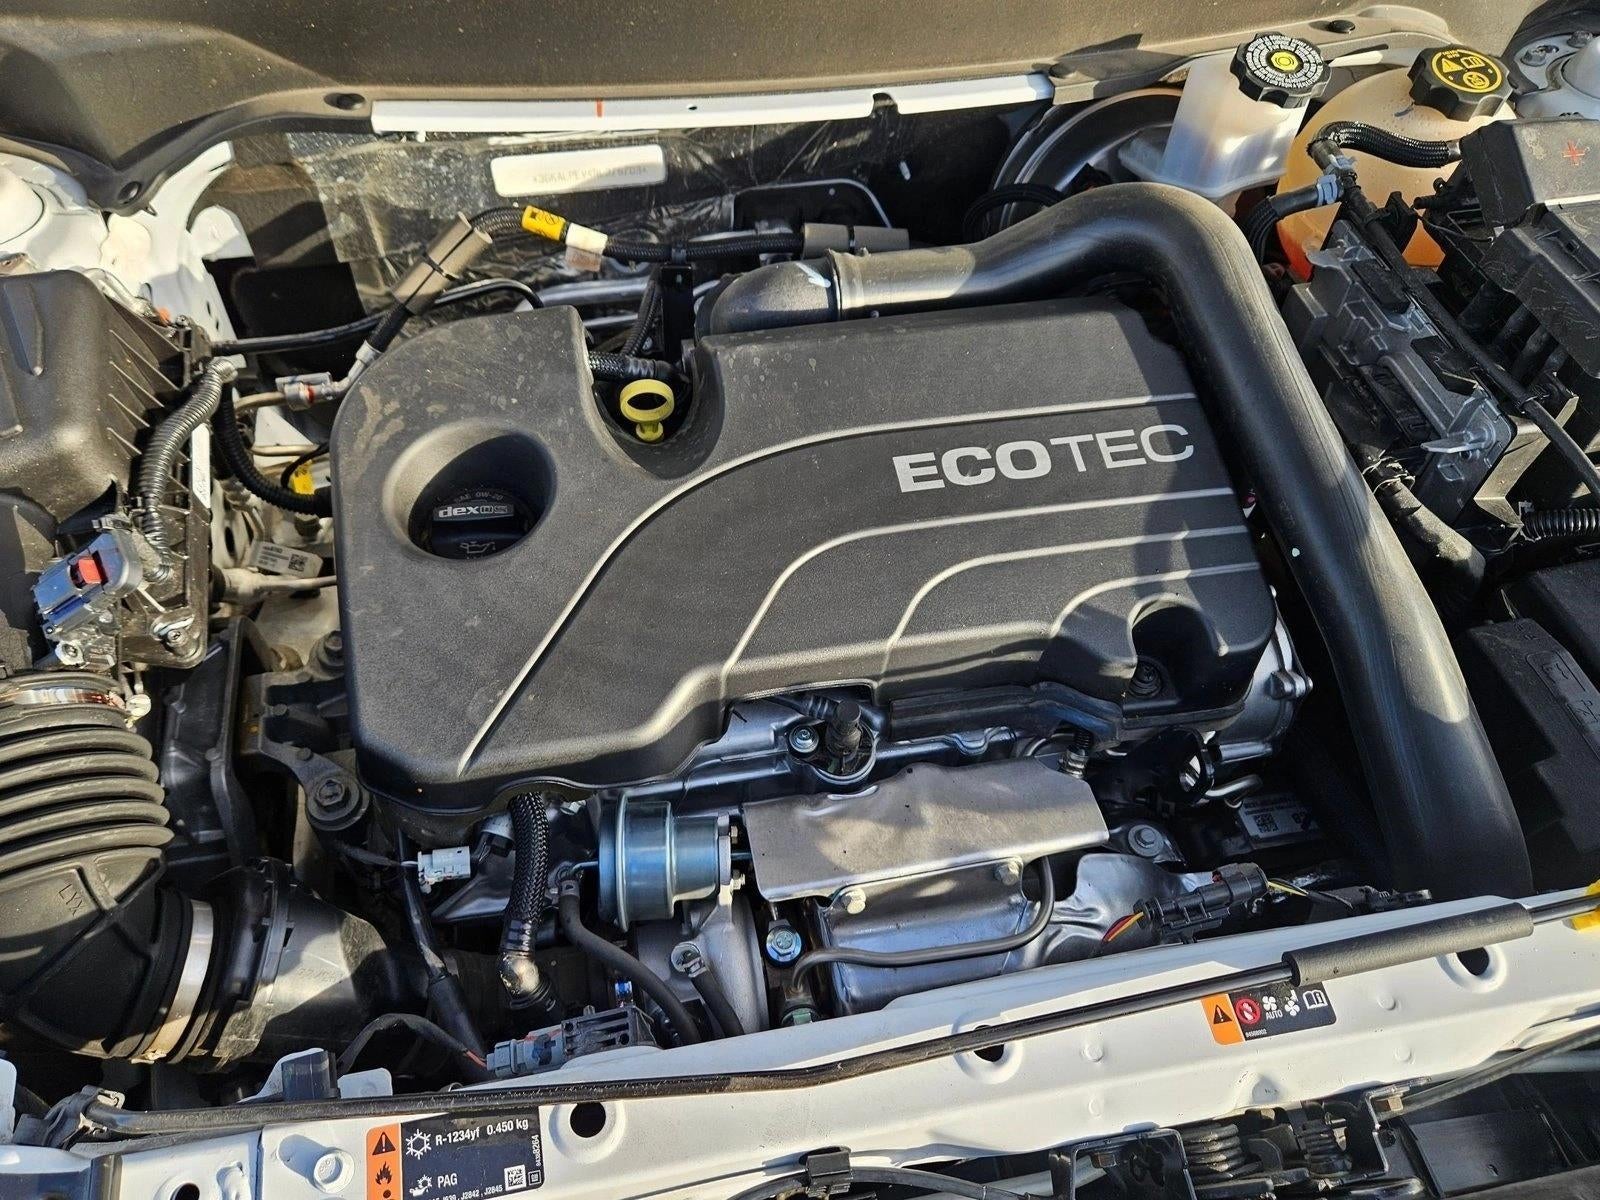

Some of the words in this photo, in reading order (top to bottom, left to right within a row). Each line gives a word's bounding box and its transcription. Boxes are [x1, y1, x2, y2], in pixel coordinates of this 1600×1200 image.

[892, 424, 1194, 493] ECOTEC
[1265, 1009, 1283, 1020] AUTO
[435, 1127, 480, 1146] R-1234yf
[486, 1120, 514, 1136] 0.450
[516, 1118, 529, 1130] kg
[437, 1173, 458, 1189] PAG
